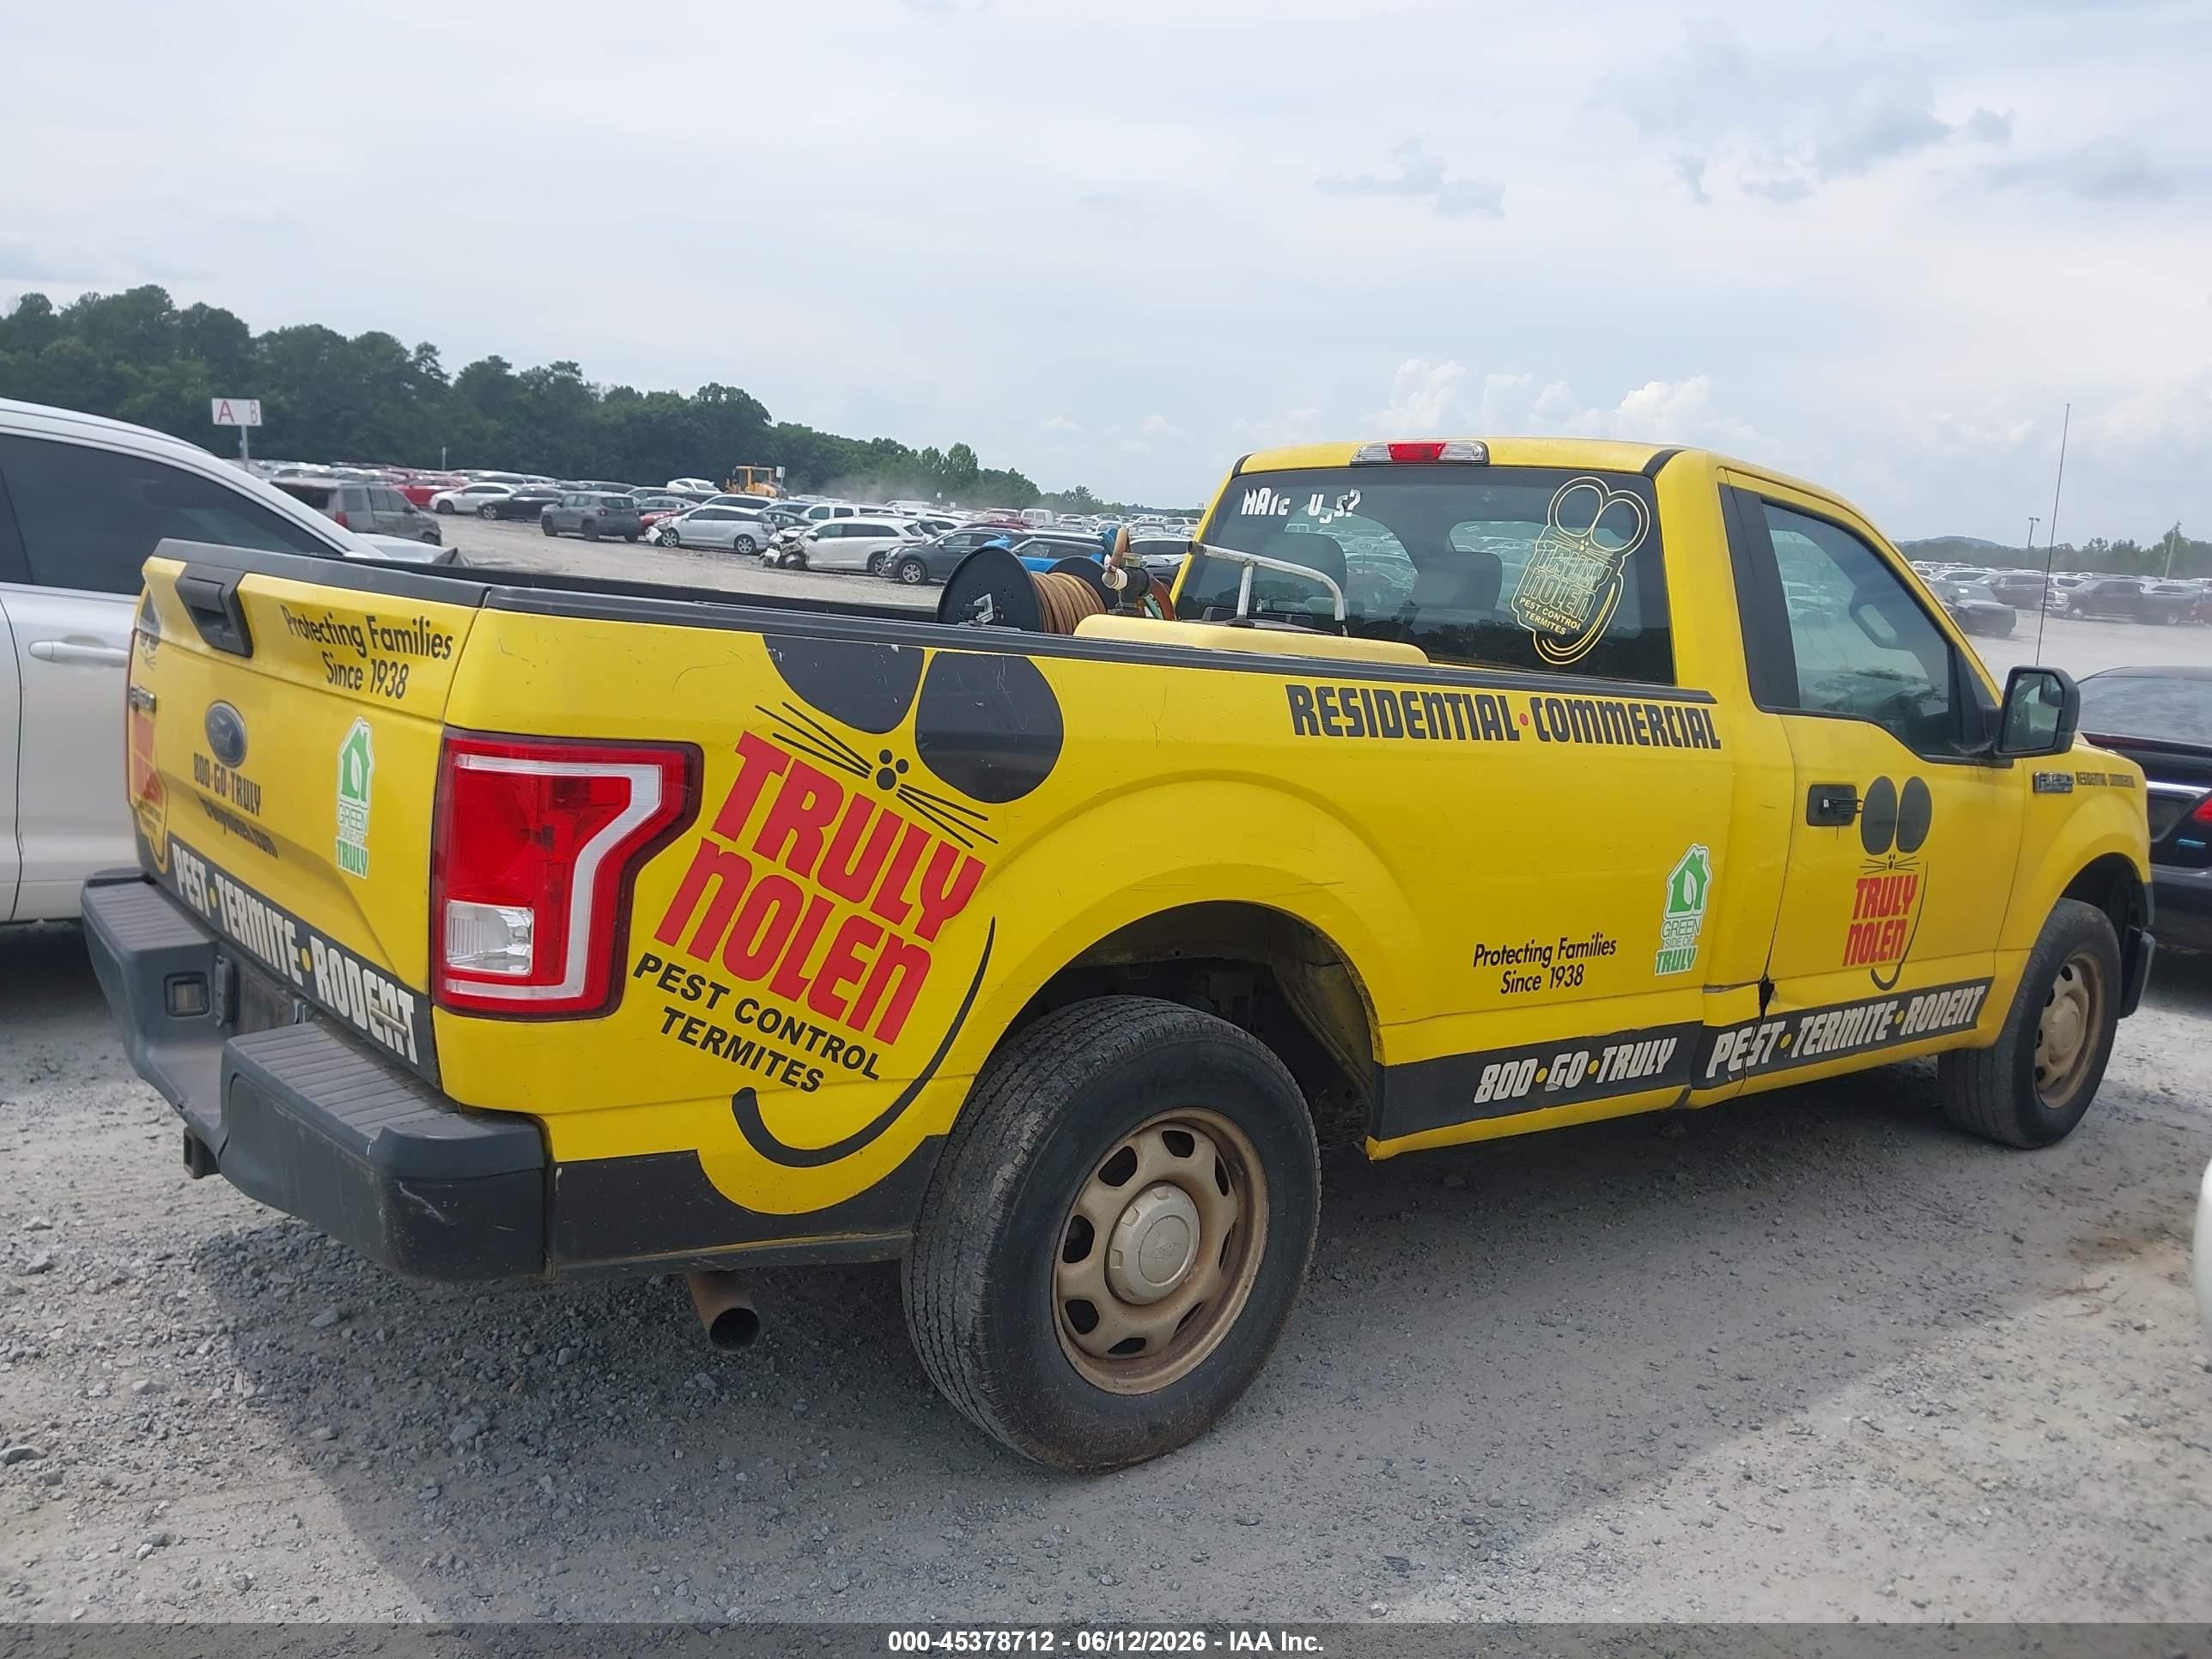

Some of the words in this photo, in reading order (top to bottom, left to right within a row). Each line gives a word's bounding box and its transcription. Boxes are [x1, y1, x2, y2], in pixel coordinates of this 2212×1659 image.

[217, 400, 234, 423] A
[1536, 539, 1613, 593] TRULY
[1519, 596, 1542, 612] PEST
[1522, 567, 1596, 623] NOLEN
[280, 604, 368, 659] Protecting
[365, 615, 453, 660] Families
[1524, 610, 1567, 635] TERMITES
[321, 650, 363, 691] Since
[369, 658, 410, 700] 1938
[1285, 684, 1521, 742] RESIDENTIAL
[1528, 696, 1723, 750] COMMERCIAL
[193, 751, 211, 790] 800
[214, 762, 228, 799] GO
[230, 769, 261, 817] TRULY
[338, 803, 368, 834] GREEN
[710, 730, 988, 943] TRULY
[337, 839, 368, 877] TRULY
[1852, 874, 1919, 921] TRULY
[653, 836, 933, 1046] NOLEN
[1473, 939, 1553, 969] Protecting
[1557, 932, 1618, 960] Families
[1662, 916, 1701, 938] GREEN
[1841, 918, 1908, 967] NOLEN
[172, 842, 211, 918] PEST
[214, 872, 304, 987] TERMITE
[309, 934, 419, 1066] RODENT
[1500, 969, 1542, 995] Since
[1549, 963, 1585, 989] 1938
[1655, 947, 1698, 975] TRULY
[632, 951, 732, 1011] PEST
[733, 996, 882, 1081] CONTROL
[1705, 1020, 1787, 1079] PEST
[1790, 1000, 1899, 1060] TERMITE
[1899, 985, 1987, 1036] RODENT
[659, 1005, 825, 1094] TERMITES
[1473, 1058, 1539, 1104] 800
[1544, 1050, 1589, 1092] GO
[1595, 1036, 1679, 1085] TRULY
